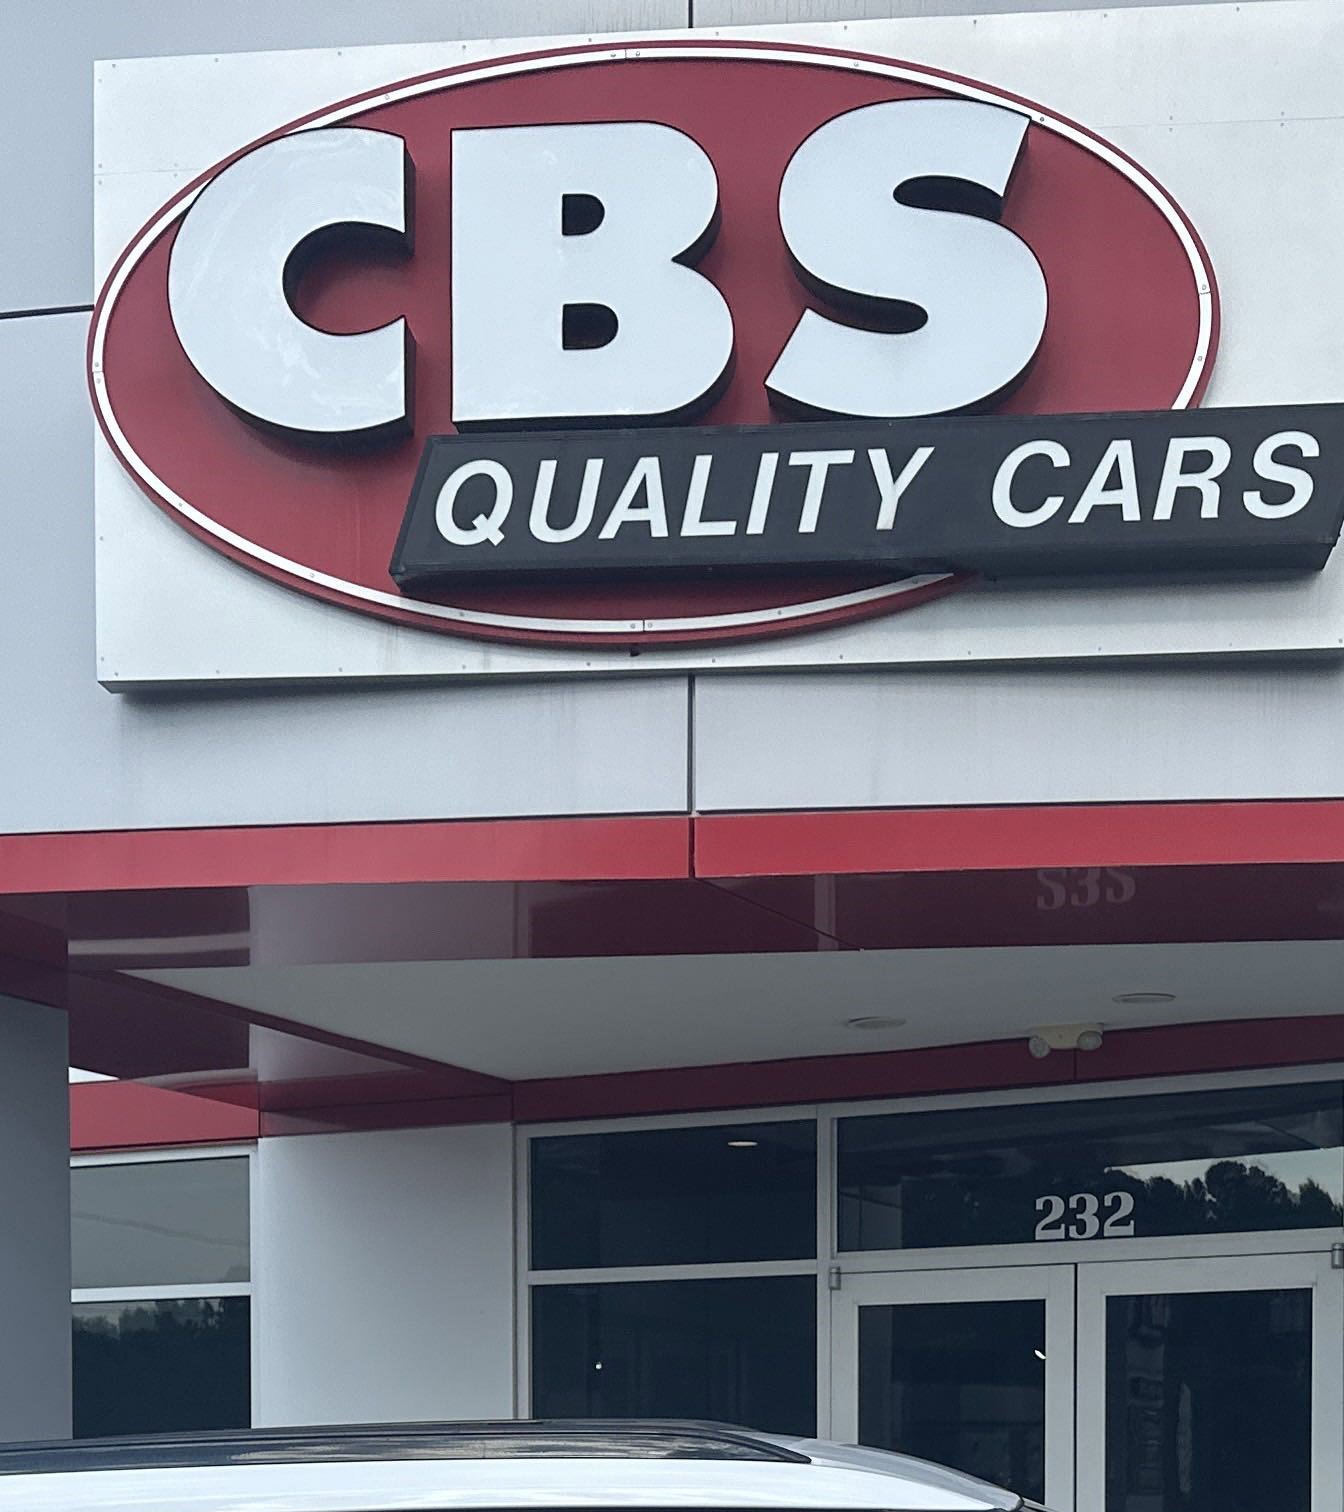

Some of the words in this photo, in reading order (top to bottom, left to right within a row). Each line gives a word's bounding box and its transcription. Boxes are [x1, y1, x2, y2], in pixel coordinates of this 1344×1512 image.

[167, 96, 1050, 441] CBS
[432, 444, 936, 548] QUALITY
[990, 428, 1324, 528] CARS
[1034, 1191, 1135, 1241] 232
